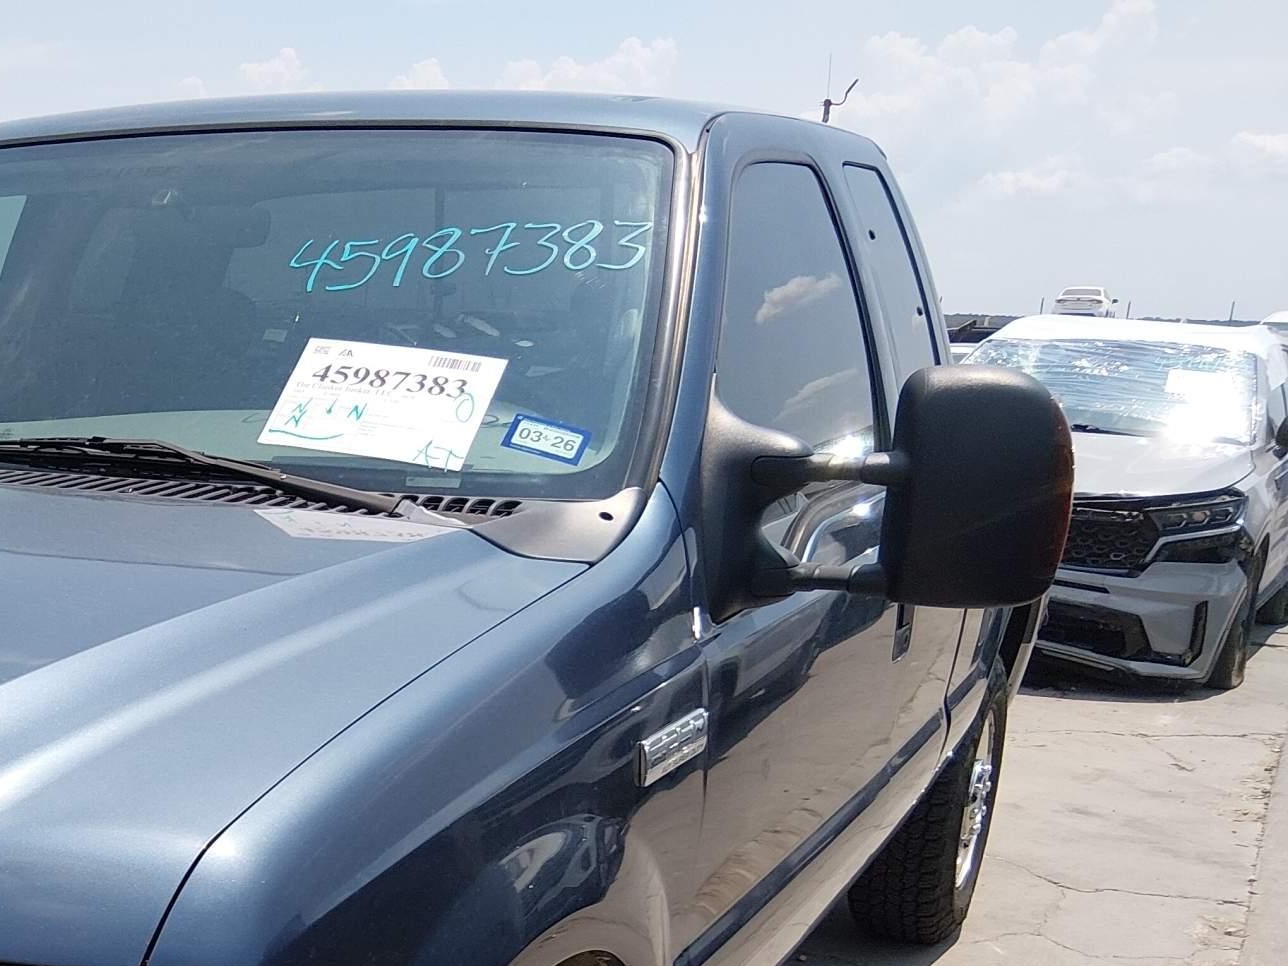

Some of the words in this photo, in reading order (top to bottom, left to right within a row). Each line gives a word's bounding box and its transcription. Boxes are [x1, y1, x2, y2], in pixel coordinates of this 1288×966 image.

[289, 220, 654, 293] 45987383
[311, 363, 468, 399] 45987383
[518, 427, 543, 443] 03
[550, 435, 577, 452] 26
